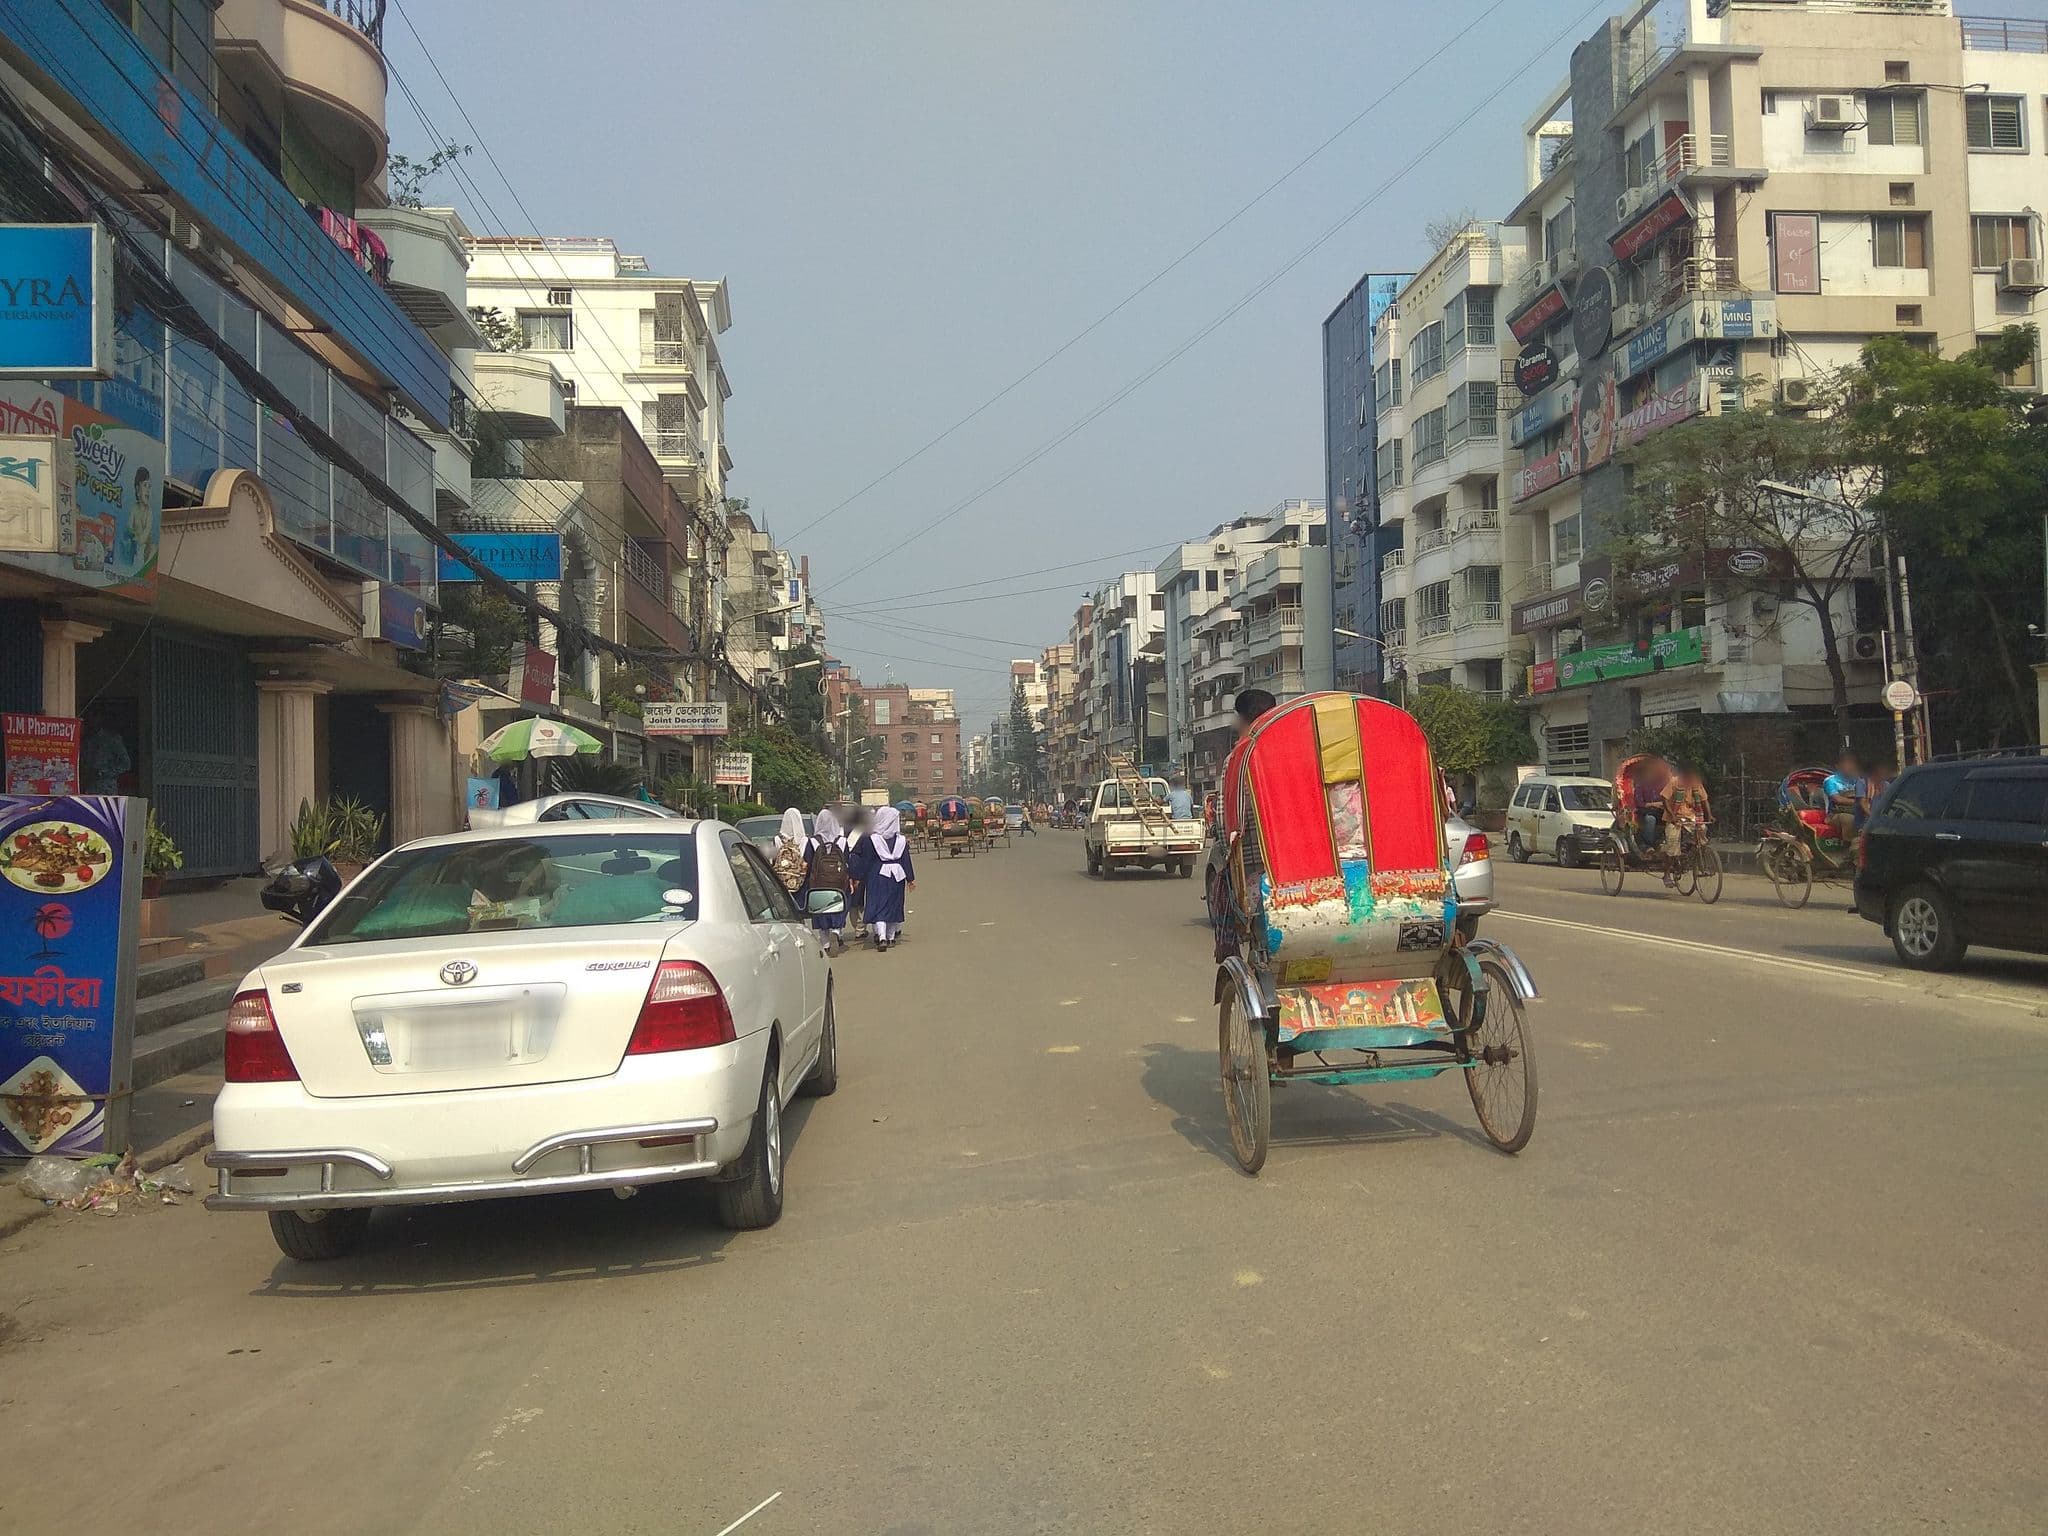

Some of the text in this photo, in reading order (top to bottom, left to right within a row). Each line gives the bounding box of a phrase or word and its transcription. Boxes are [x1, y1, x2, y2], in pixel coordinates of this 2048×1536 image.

[1723, 312, 1751, 322] MING
[1699, 366, 1734, 376] MING
[1628, 386, 1684, 431] MING
[72, 423, 125, 481] Sweety
[28, 717, 76, 741] Pharmacy
[585, 960, 651, 971] COROLLA
